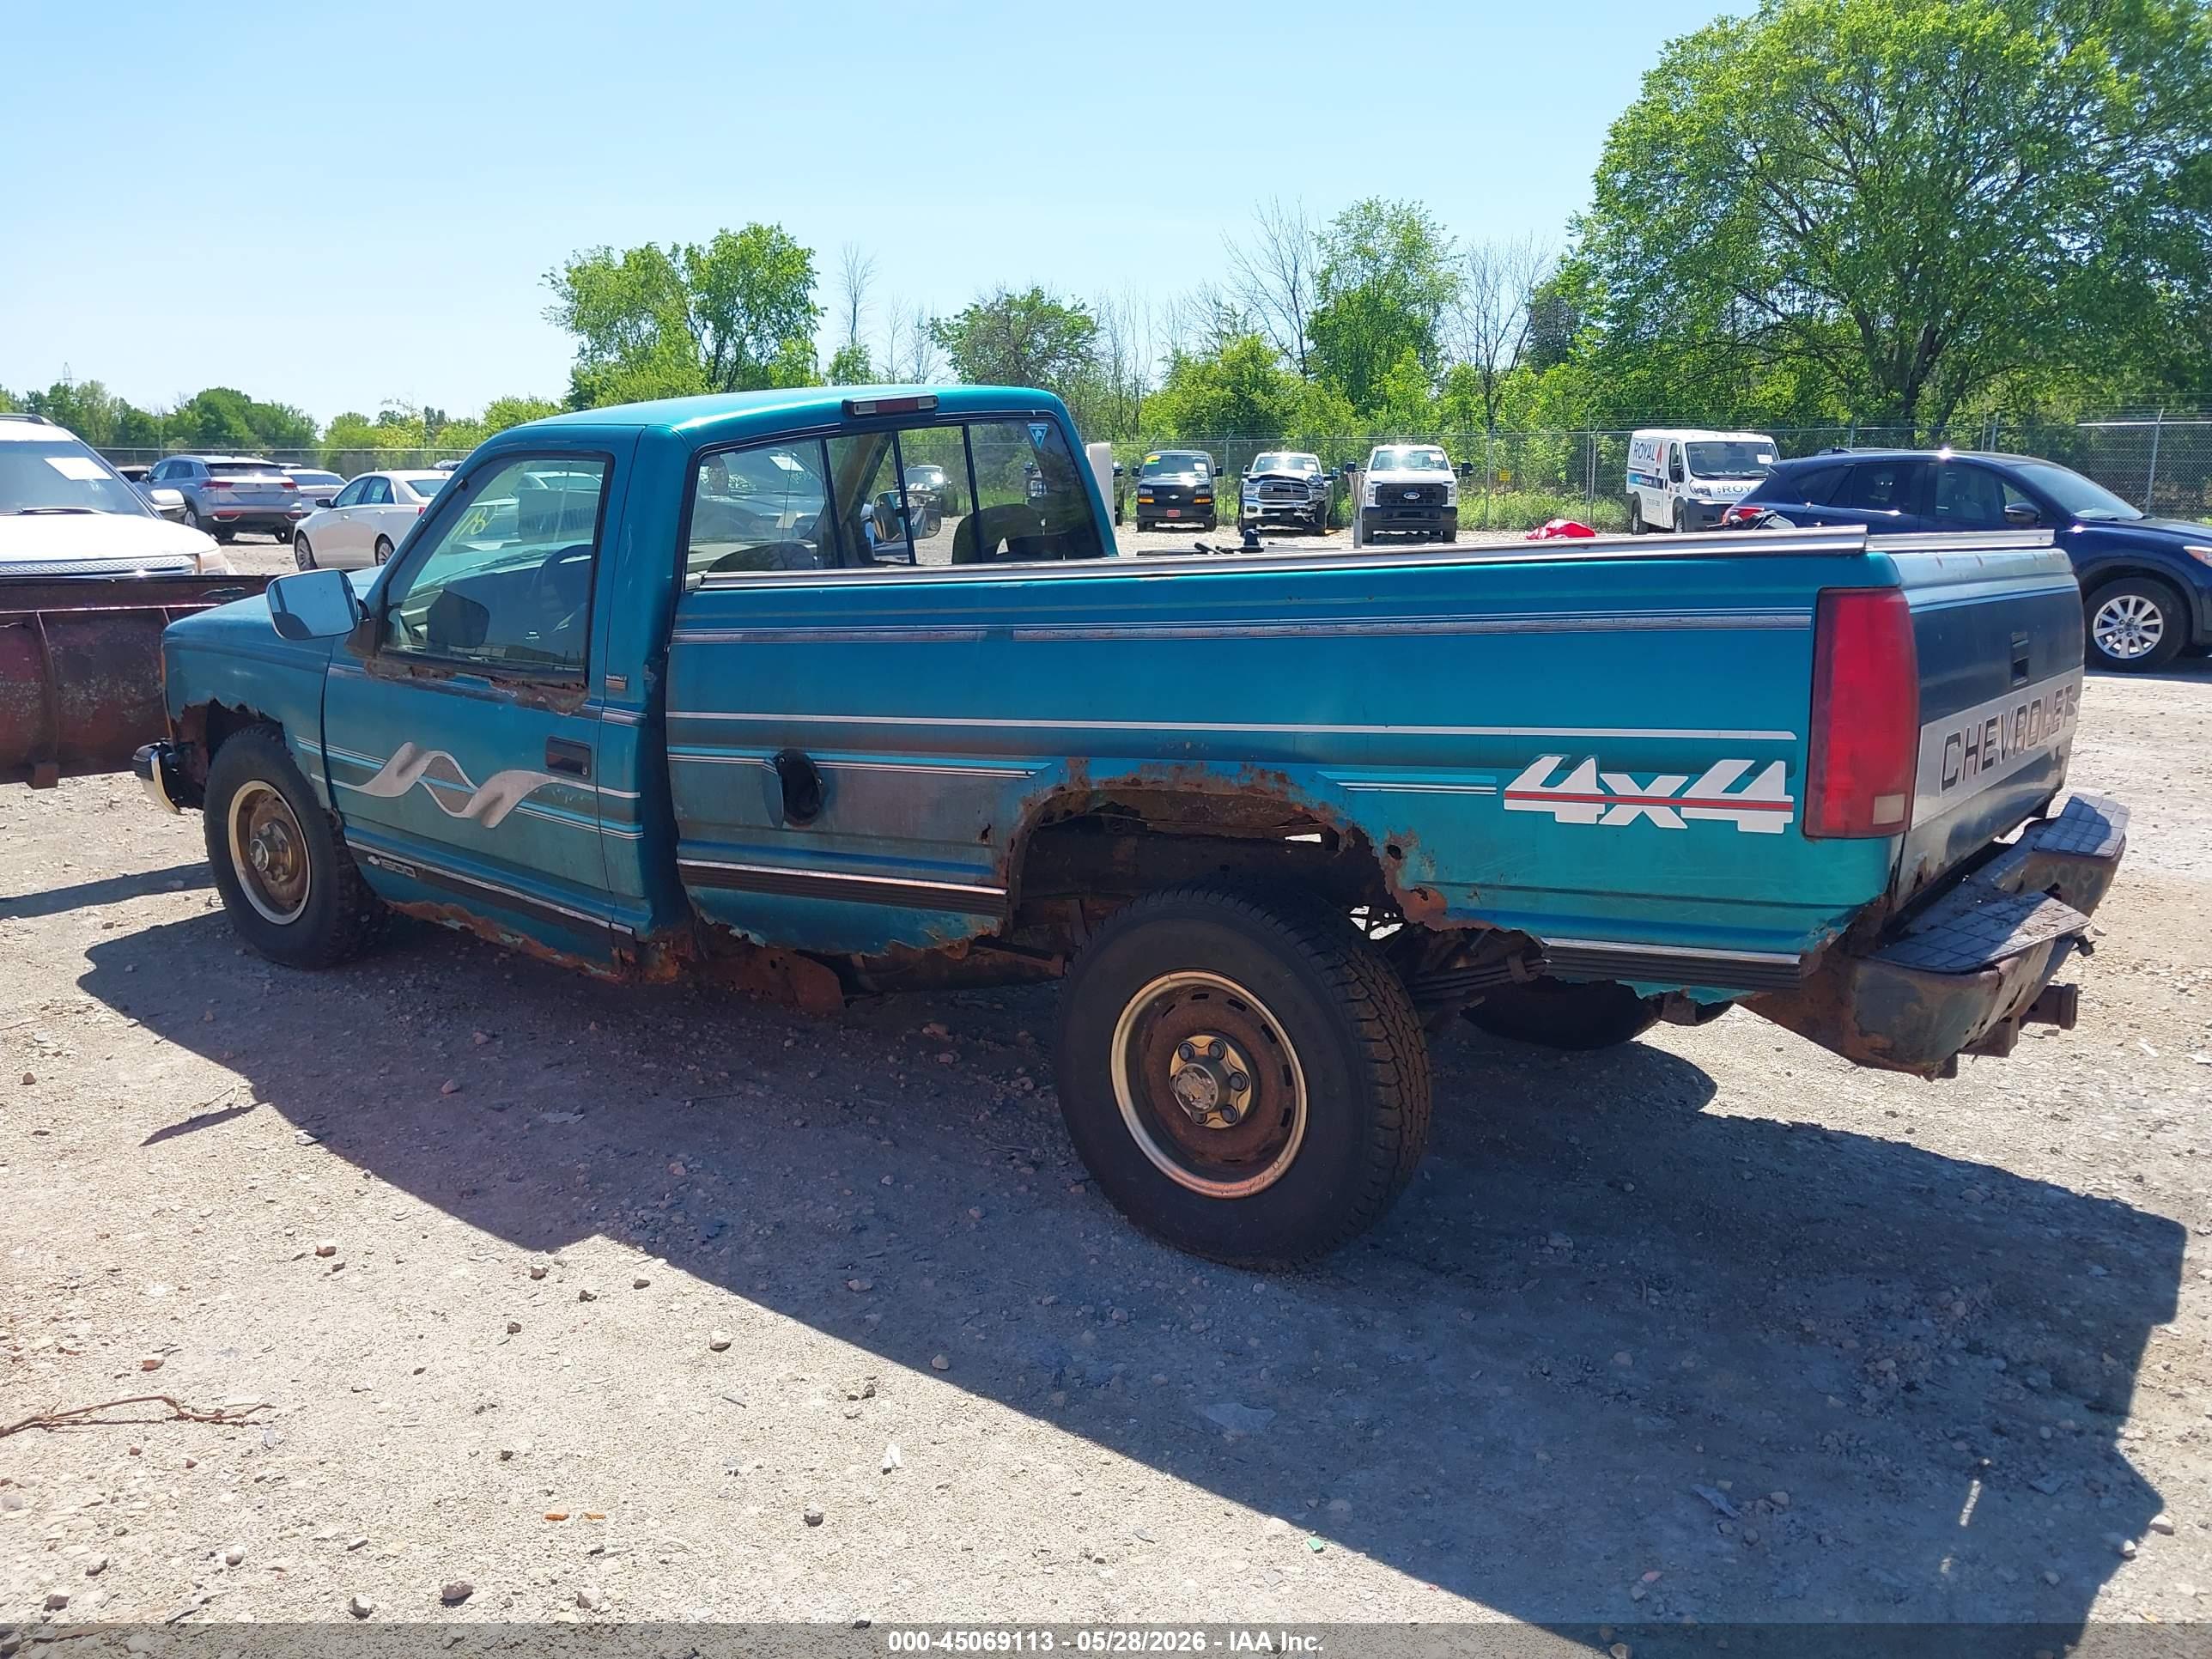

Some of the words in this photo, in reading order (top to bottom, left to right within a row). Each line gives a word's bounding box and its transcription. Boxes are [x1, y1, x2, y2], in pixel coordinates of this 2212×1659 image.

[1633, 441, 1656, 462] ROYAL
[1940, 684, 2074, 794] CHEVROLET
[1504, 755, 1795, 835] 4x4
